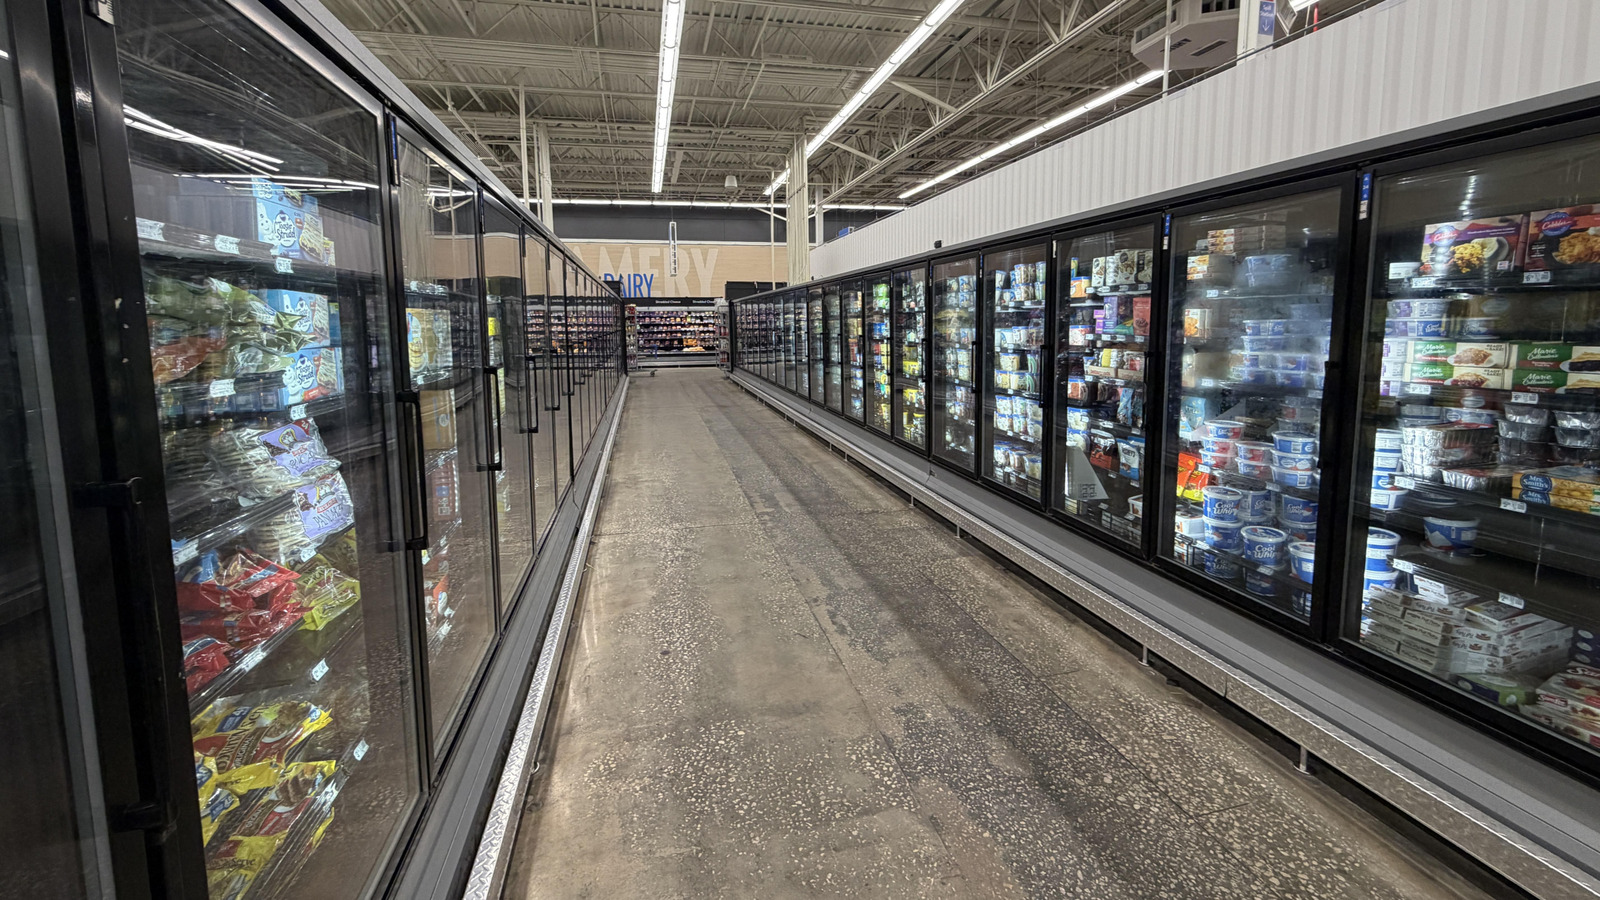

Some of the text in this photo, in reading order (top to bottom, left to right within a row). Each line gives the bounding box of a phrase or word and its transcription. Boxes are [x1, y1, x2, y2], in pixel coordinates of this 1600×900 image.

[1523, 479, 1549, 488] Smith's
[1522, 495, 1547, 504] Smith's
[1215, 501, 1234, 509] Cool
[1213, 507, 1239, 516] Whip
[1255, 544, 1276, 552] Cool
